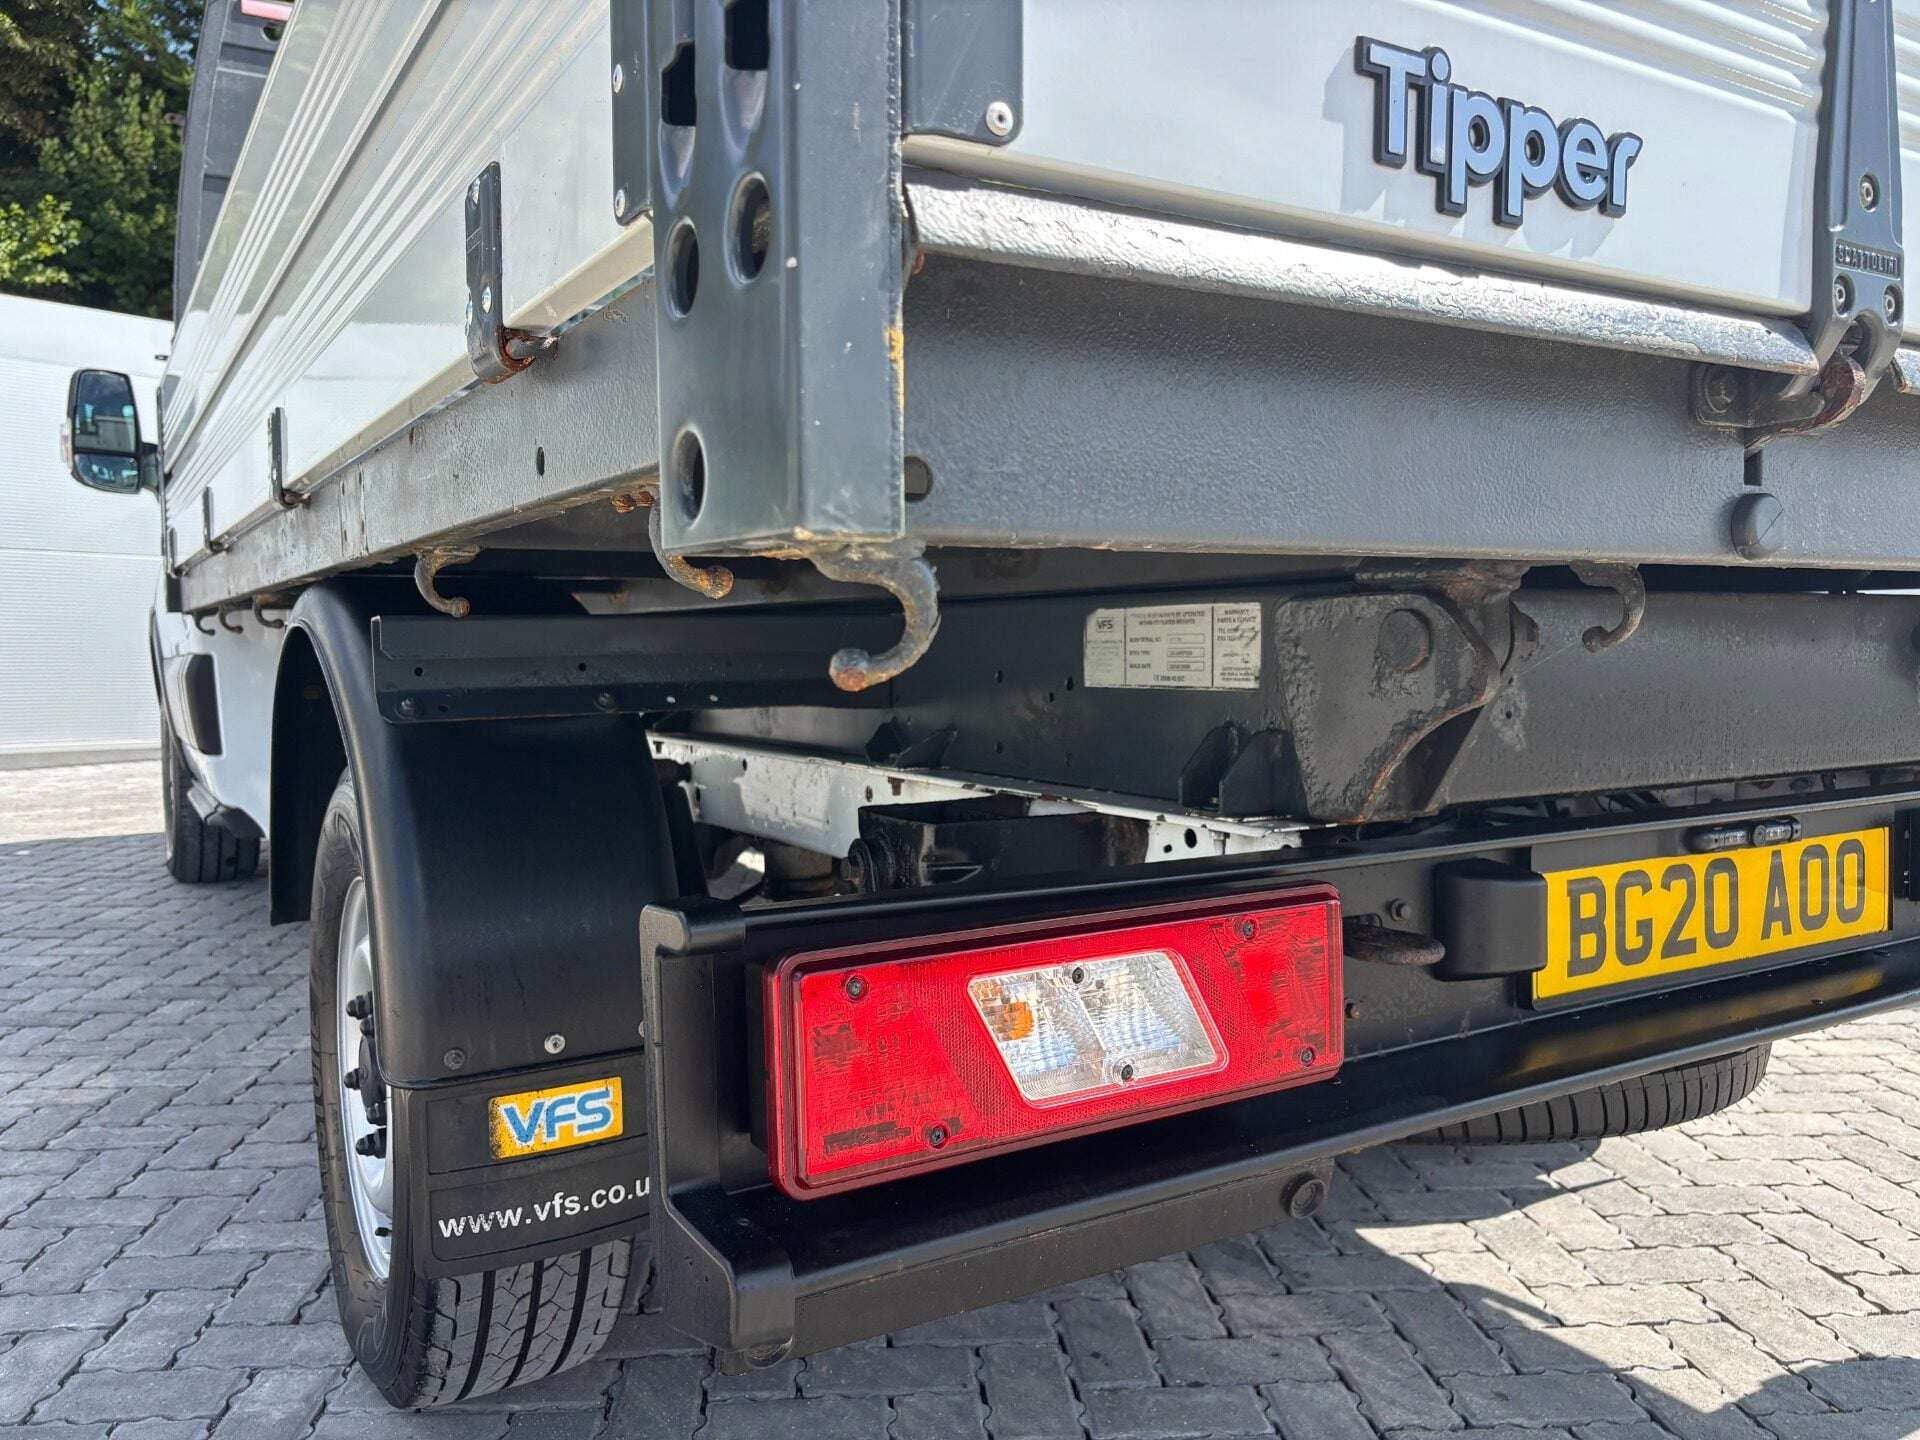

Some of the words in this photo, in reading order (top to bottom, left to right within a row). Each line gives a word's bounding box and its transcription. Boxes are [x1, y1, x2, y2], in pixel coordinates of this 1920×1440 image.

[1355, 35, 1643, 229] Tipper
[1566, 857, 1739, 978] BG20
[501, 1088, 613, 1146] VFS
